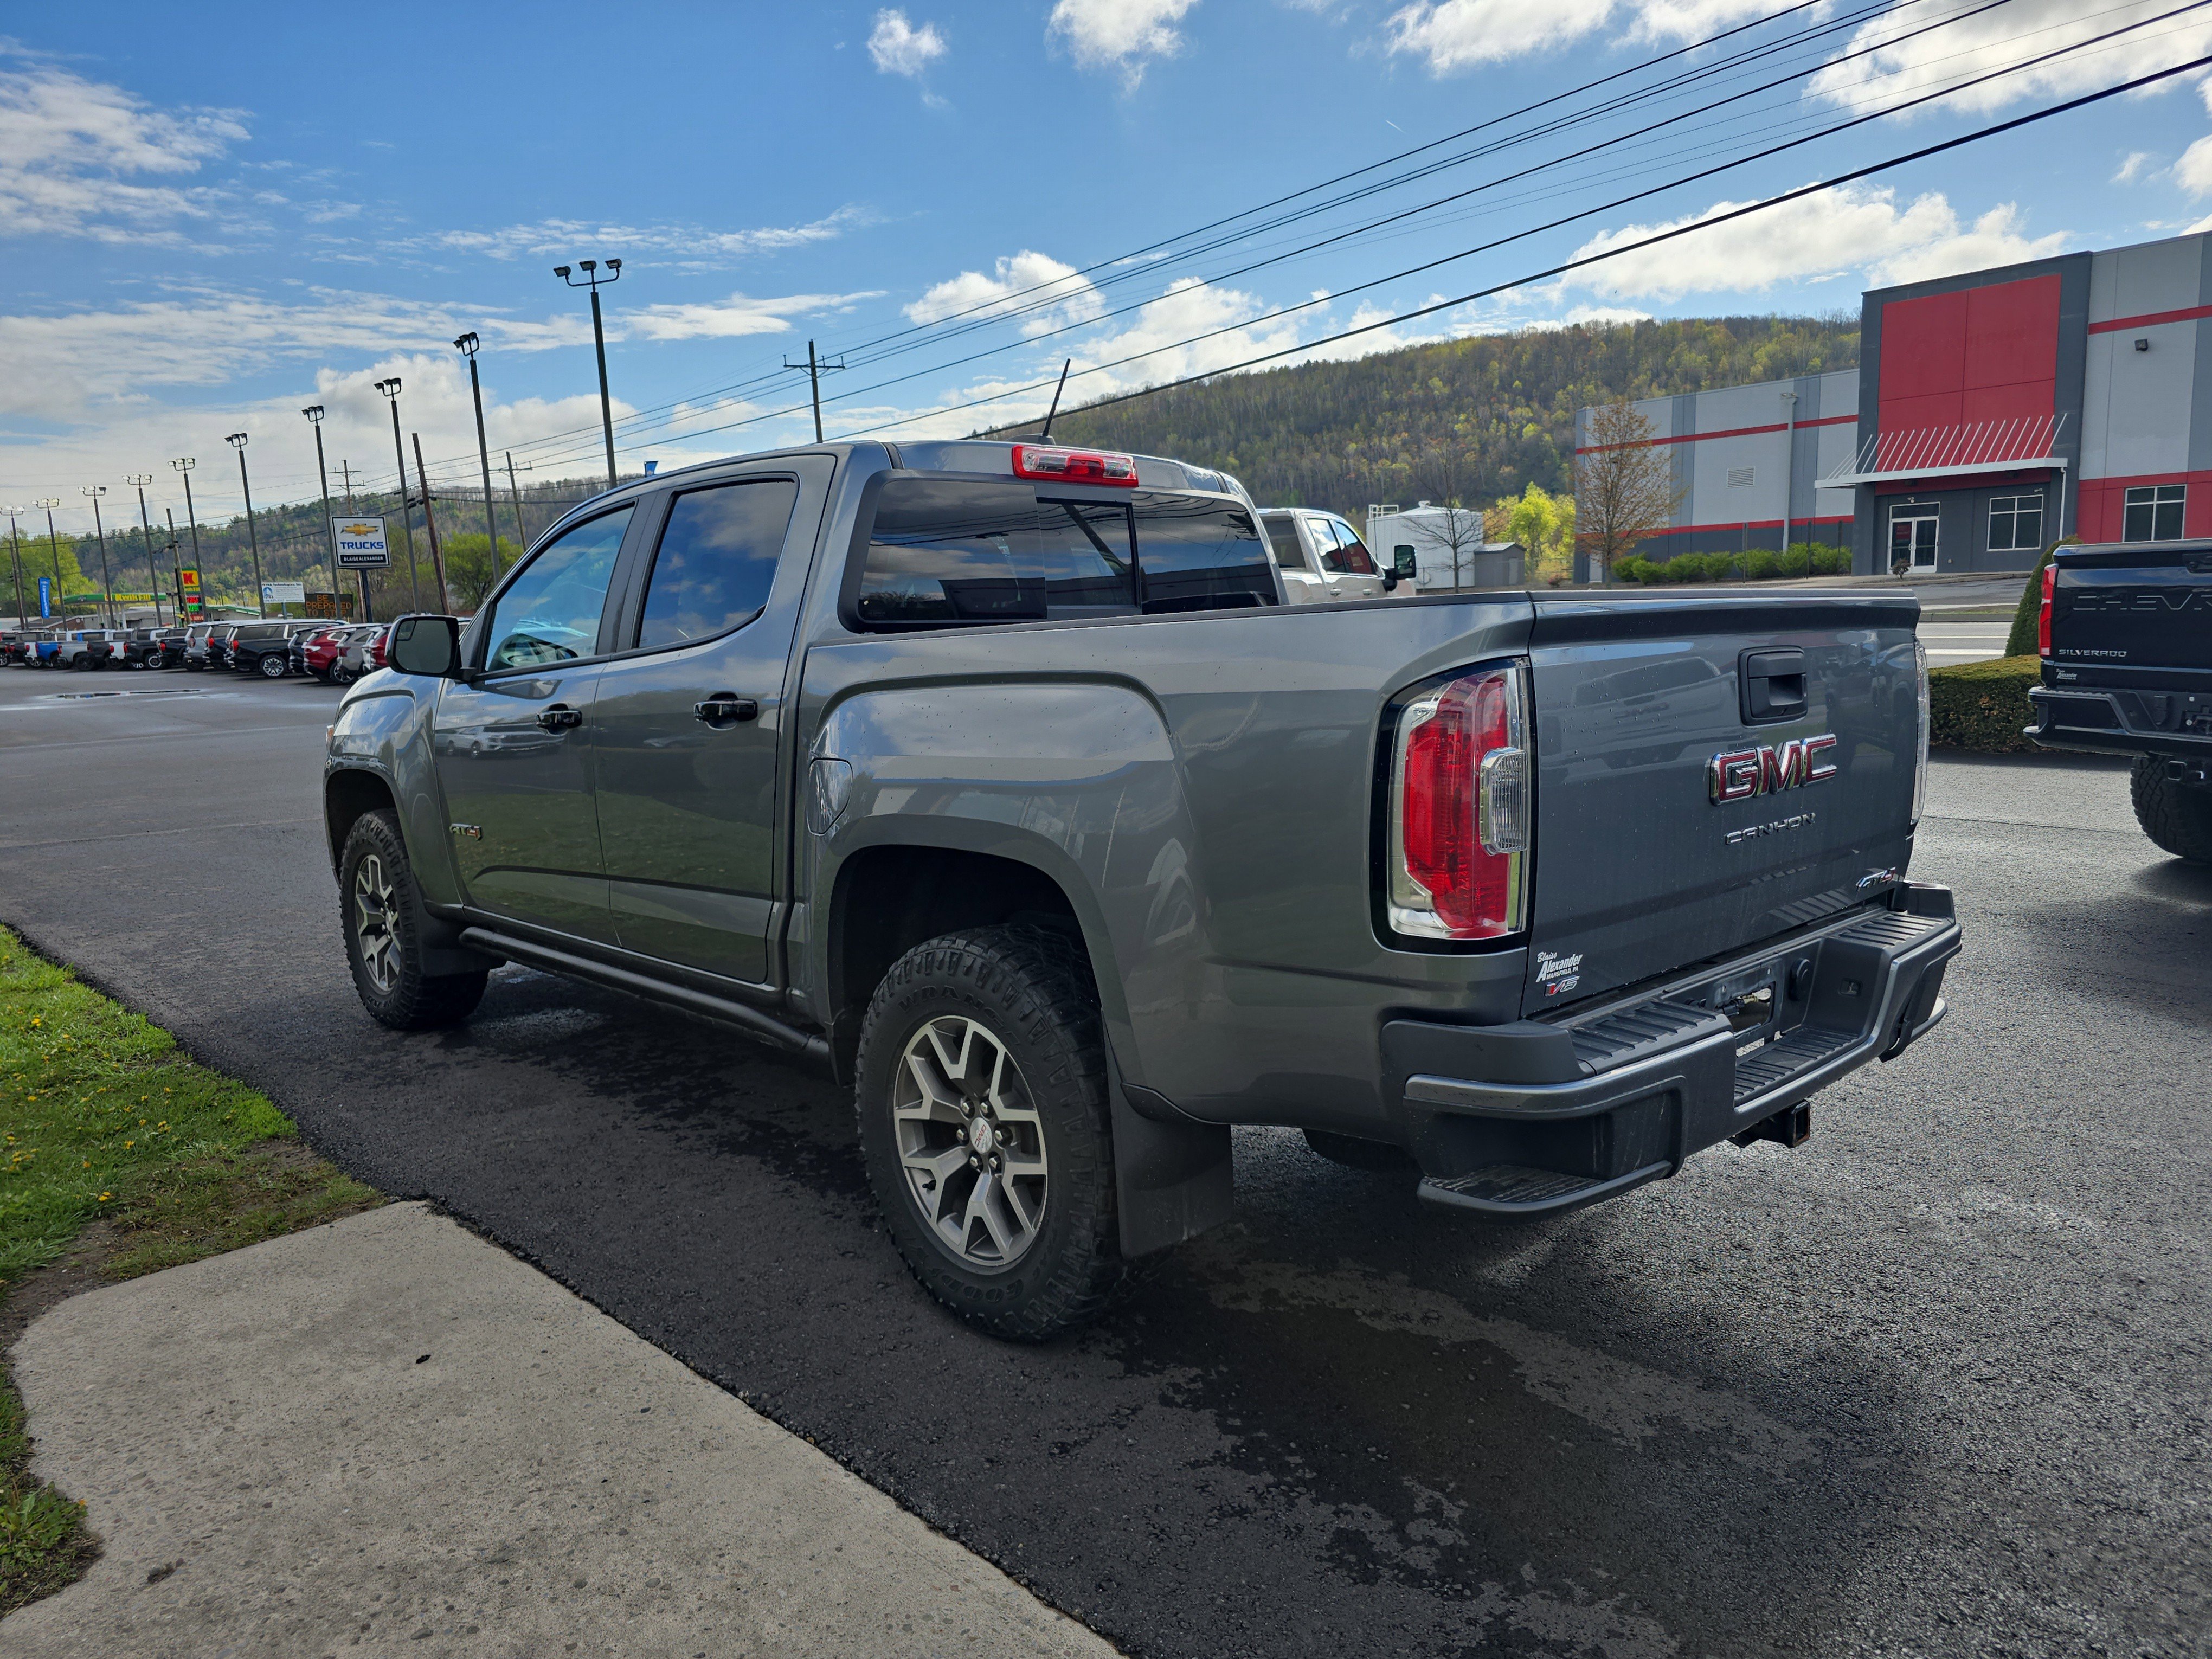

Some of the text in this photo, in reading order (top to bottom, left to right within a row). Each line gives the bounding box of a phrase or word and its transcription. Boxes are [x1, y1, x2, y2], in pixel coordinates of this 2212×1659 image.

[183, 573, 195, 584] K
[2059, 648, 2127, 657] SILVERADO
[1709, 733, 1837, 806] GMC
[1725, 812, 1816, 845] CANYON
[1535, 953, 1583, 982] Alexander
[1537, 951, 1558, 963] Blaise
[1544, 974, 1580, 997] V6
[1546, 968, 1572, 980] MANSFIELD,
[974, 1123, 987, 1148] GMC
